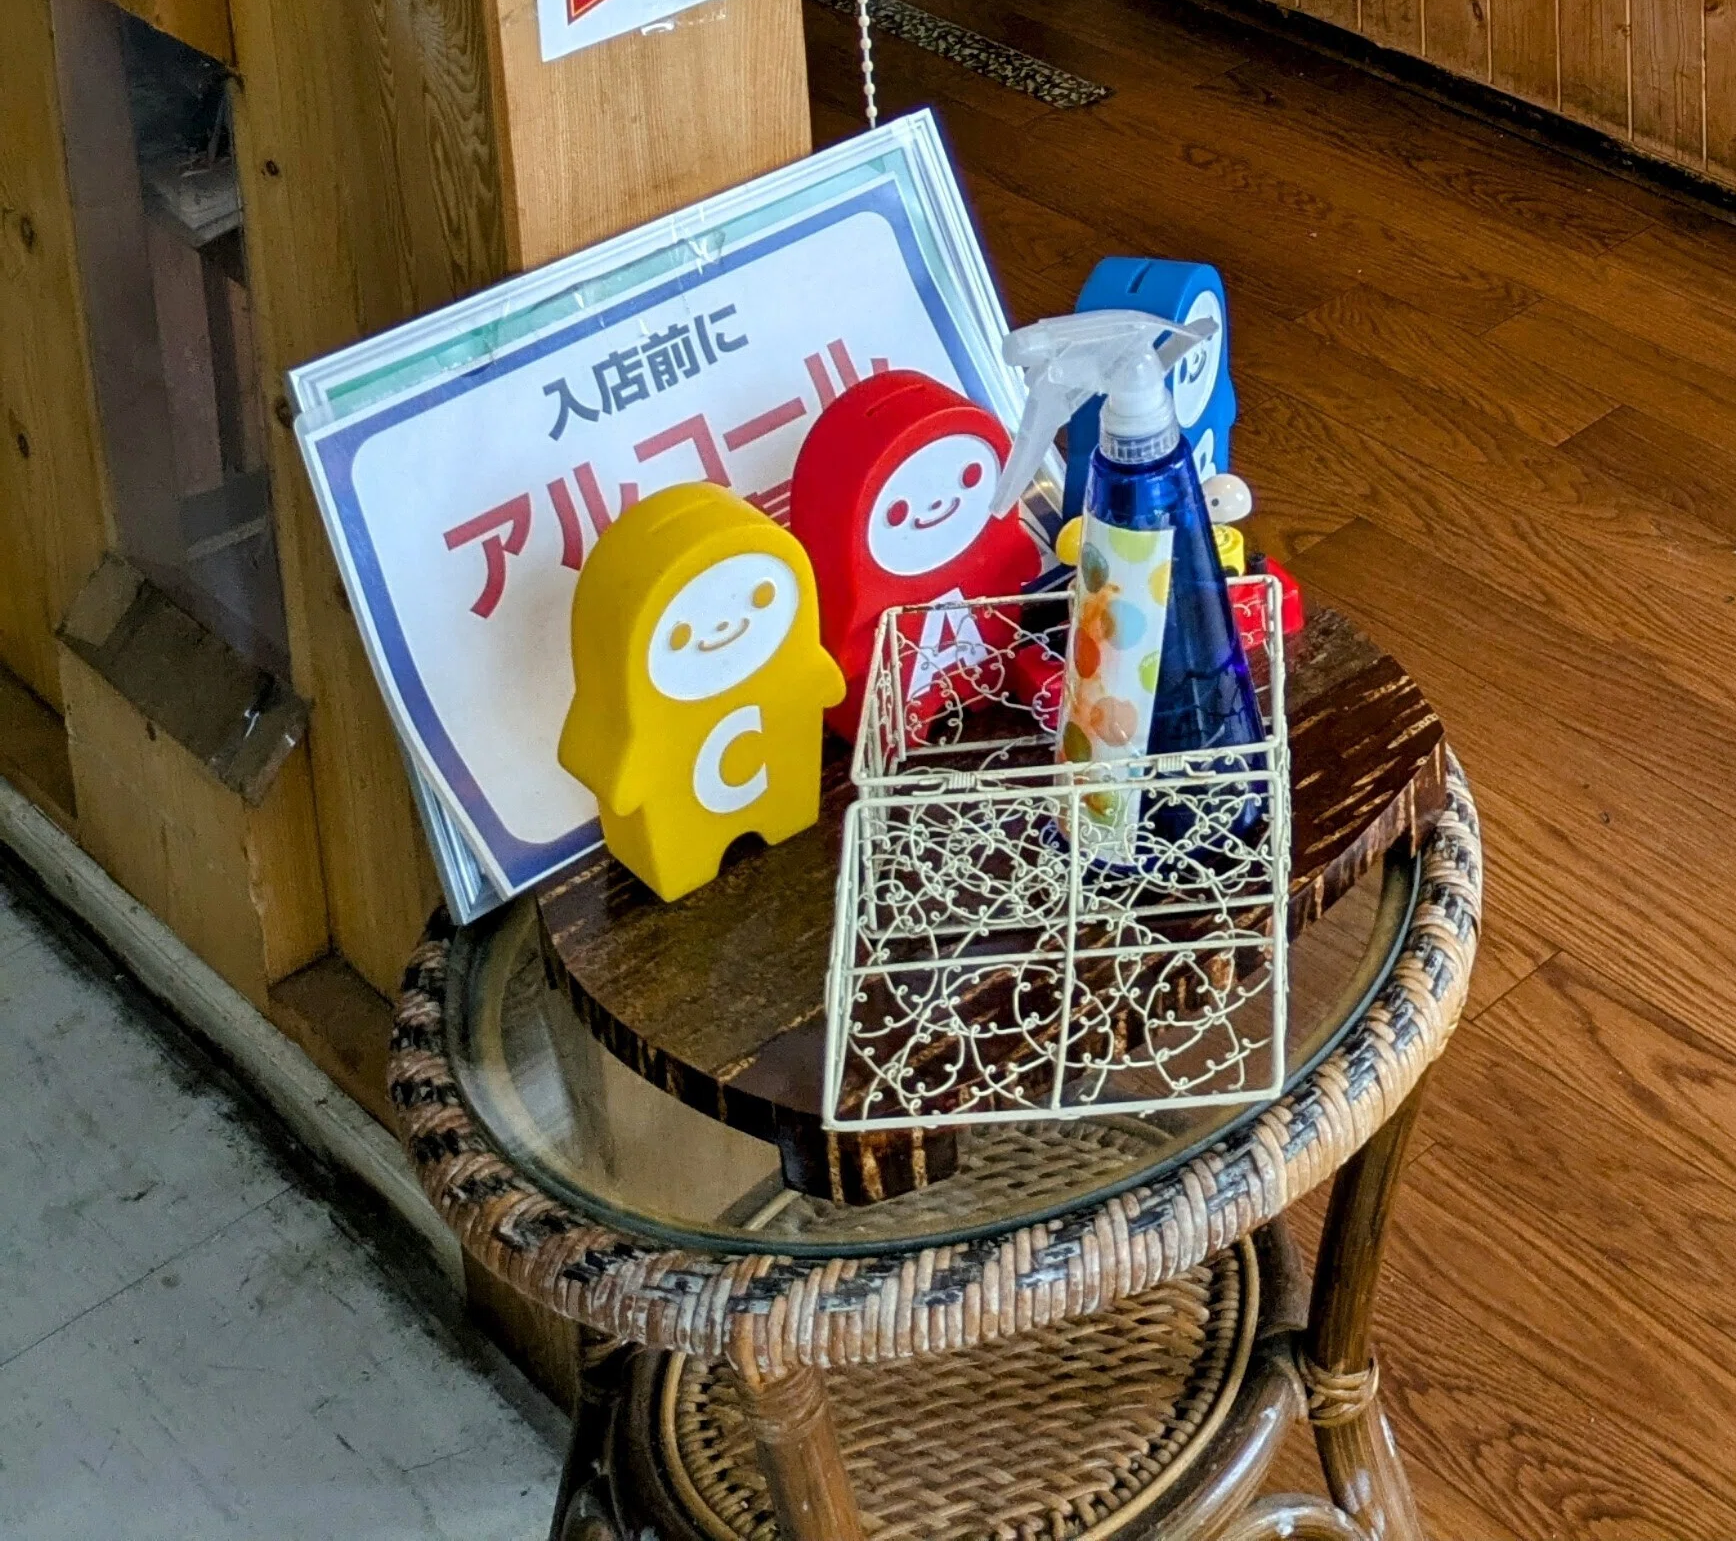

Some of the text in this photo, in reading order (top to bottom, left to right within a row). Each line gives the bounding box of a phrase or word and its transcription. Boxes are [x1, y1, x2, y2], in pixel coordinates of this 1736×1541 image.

[543, 302, 749, 441] 入店前に
[904, 586, 989, 701] A
[692, 703, 770, 815] C
